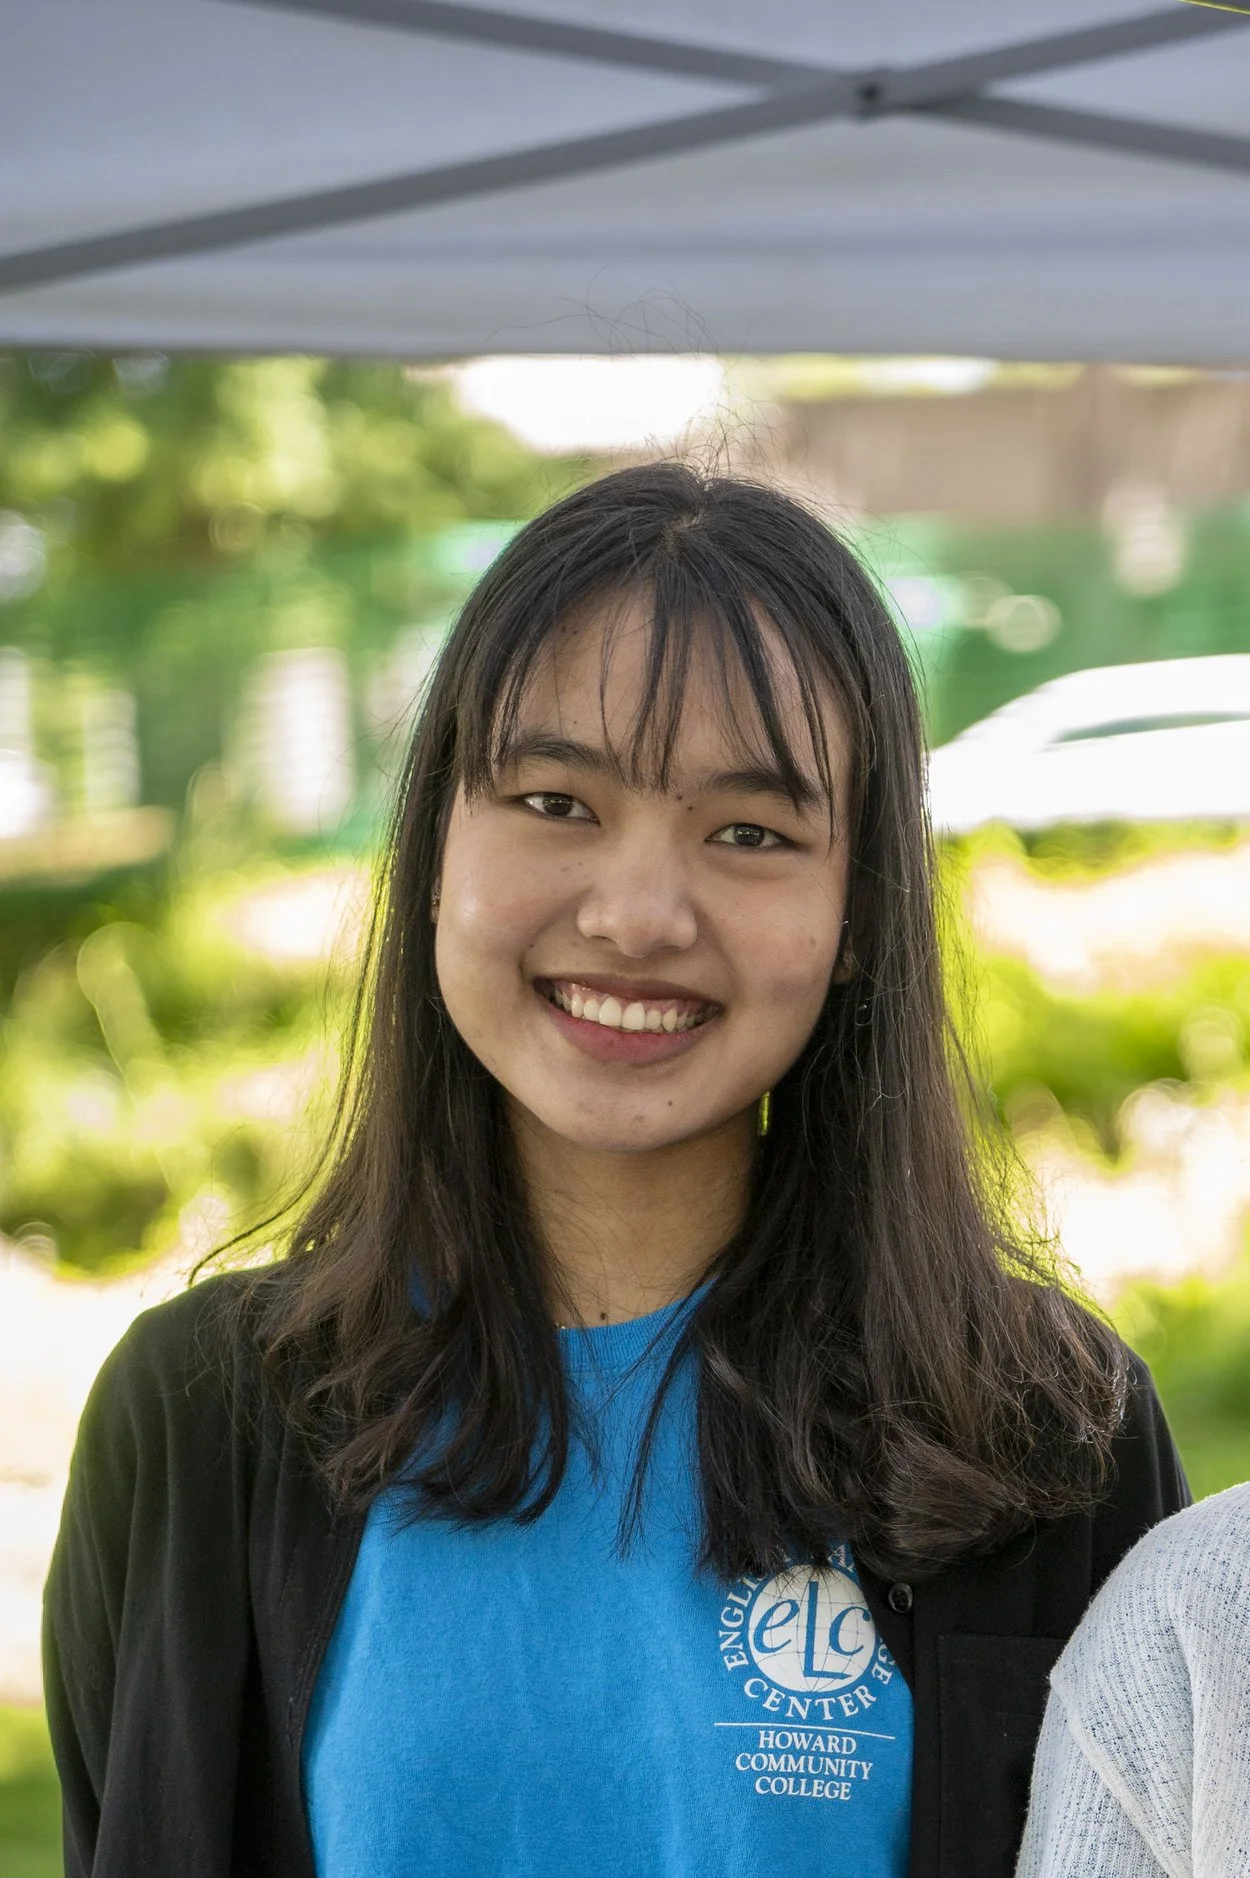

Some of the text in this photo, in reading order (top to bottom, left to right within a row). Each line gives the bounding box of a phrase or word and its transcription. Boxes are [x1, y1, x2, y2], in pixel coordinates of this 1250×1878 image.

[743, 1677, 877, 1721] CENTER
[758, 1729, 857, 1754] HOWARD
[735, 1752, 873, 1780] COMMUNITY
[755, 1775, 853, 1800] COLLEGE
